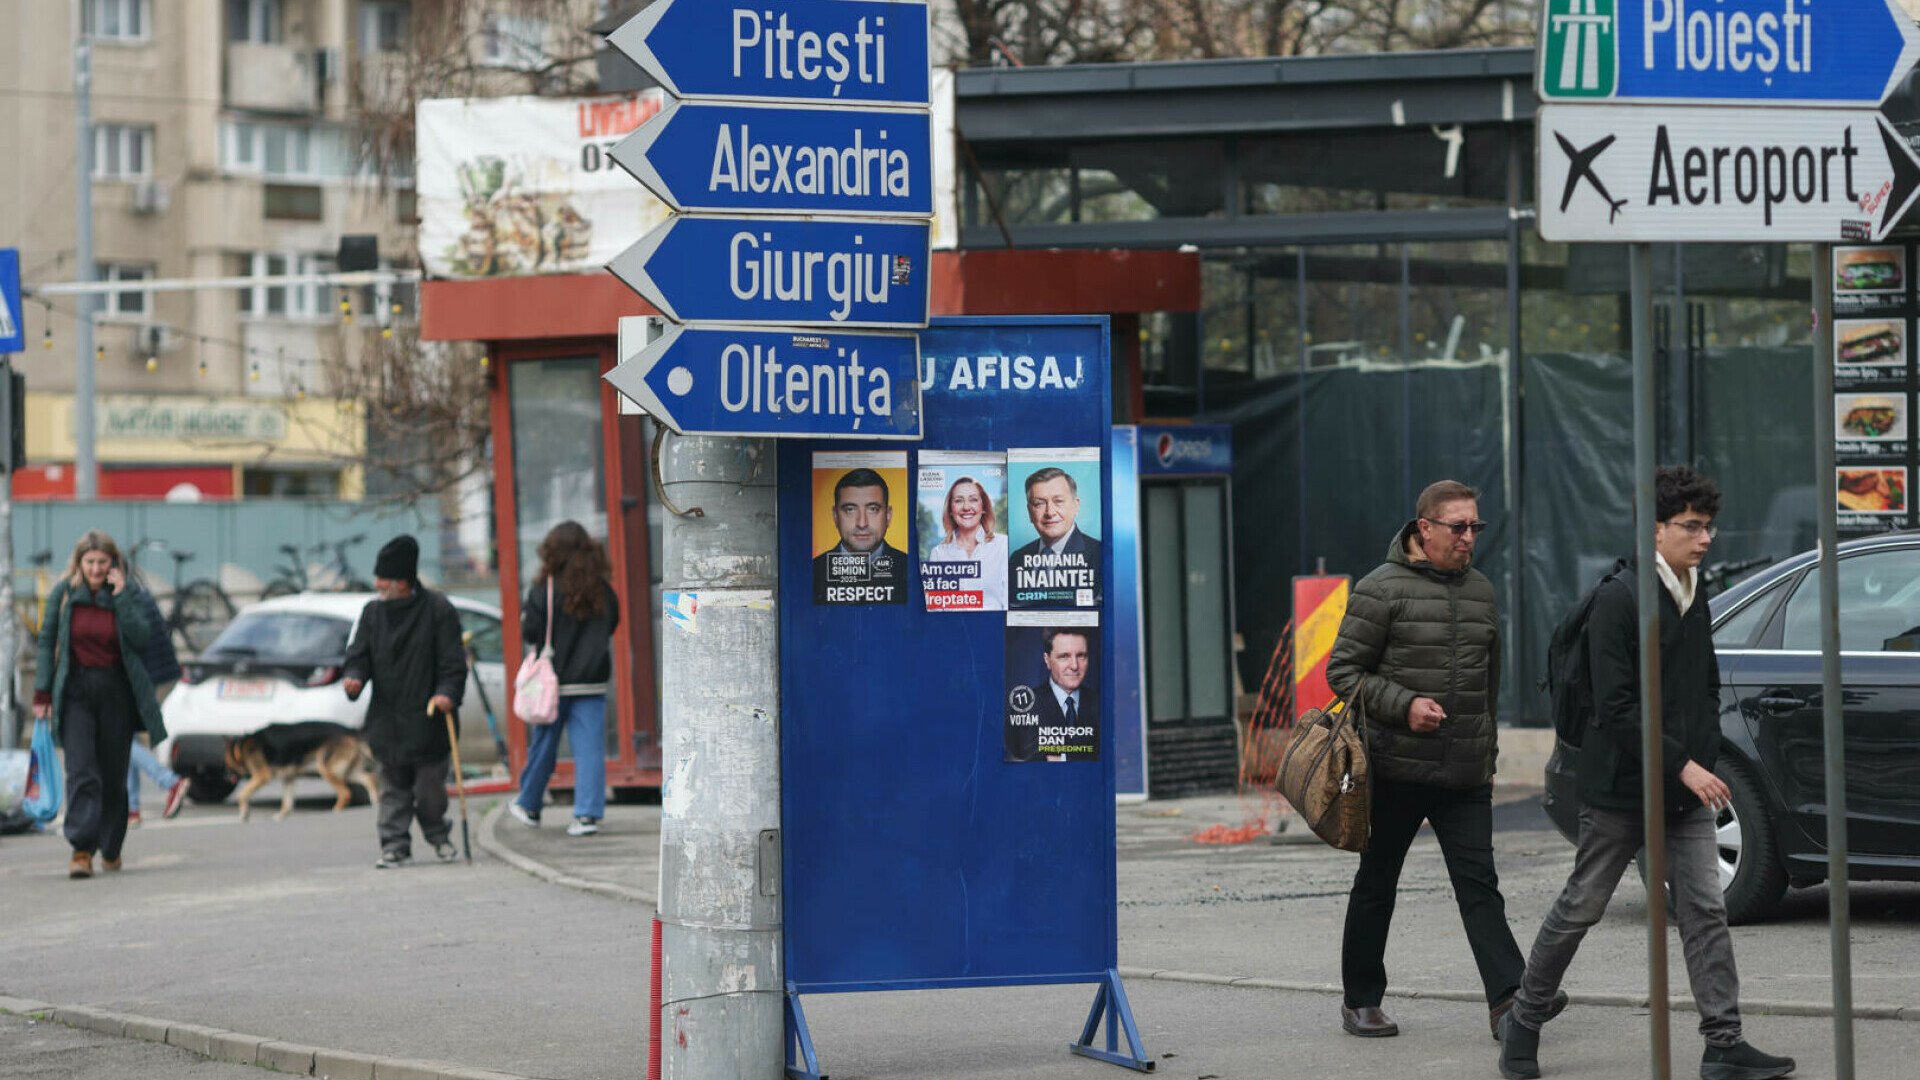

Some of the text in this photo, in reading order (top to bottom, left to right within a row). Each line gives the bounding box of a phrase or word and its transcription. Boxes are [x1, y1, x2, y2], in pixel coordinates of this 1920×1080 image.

[732, 8, 885, 97] Pitești
[1643, 0, 1811, 86] Ploiești
[708, 123, 910, 197] Alexandria
[1646, 124, 1859, 226] Aeroport
[729, 231, 889, 321] Giurgiu
[949, 355, 1084, 391] AFISAJ
[720, 343, 891, 430] Oltenița
[832, 556, 866, 565] GEORGE
[922, 562, 978, 577] Am curaj
[832, 566, 867, 576] SIMION
[1016, 566, 1094, 589] ÎNAINTE!
[937, 577, 957, 590] fac
[827, 586, 895, 602] RESPECT
[1016, 592, 1048, 601] CRIN
[1015, 692, 1028, 705] 11
[1038, 736, 1065, 746] DAN
